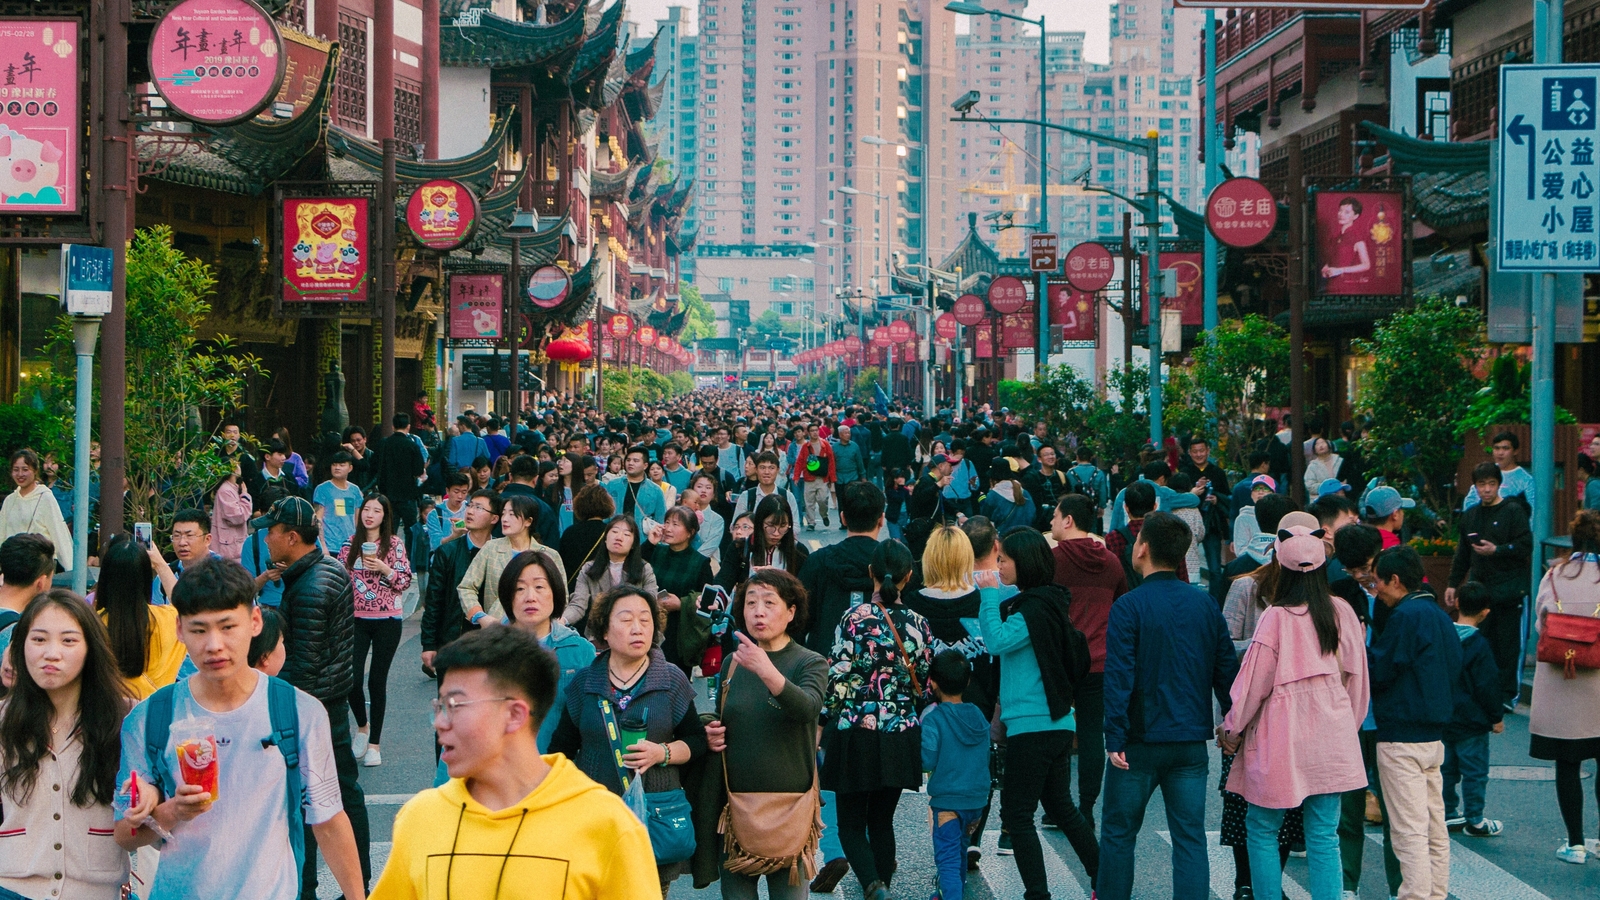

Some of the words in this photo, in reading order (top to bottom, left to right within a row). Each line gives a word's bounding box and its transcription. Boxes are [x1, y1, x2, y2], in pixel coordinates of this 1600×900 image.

[204, 55, 223, 64] 2019
[1541, 137, 1594, 166] 公益
[1541, 171, 1594, 200] 爱心
[1239, 198, 1271, 216] 老庙
[1215, 219, 1270, 229] 给您带来好运气
[1541, 205, 1594, 234] 小屋
[1088, 257, 1110, 269] 老庙
[1006, 286, 1024, 297] 老庙
